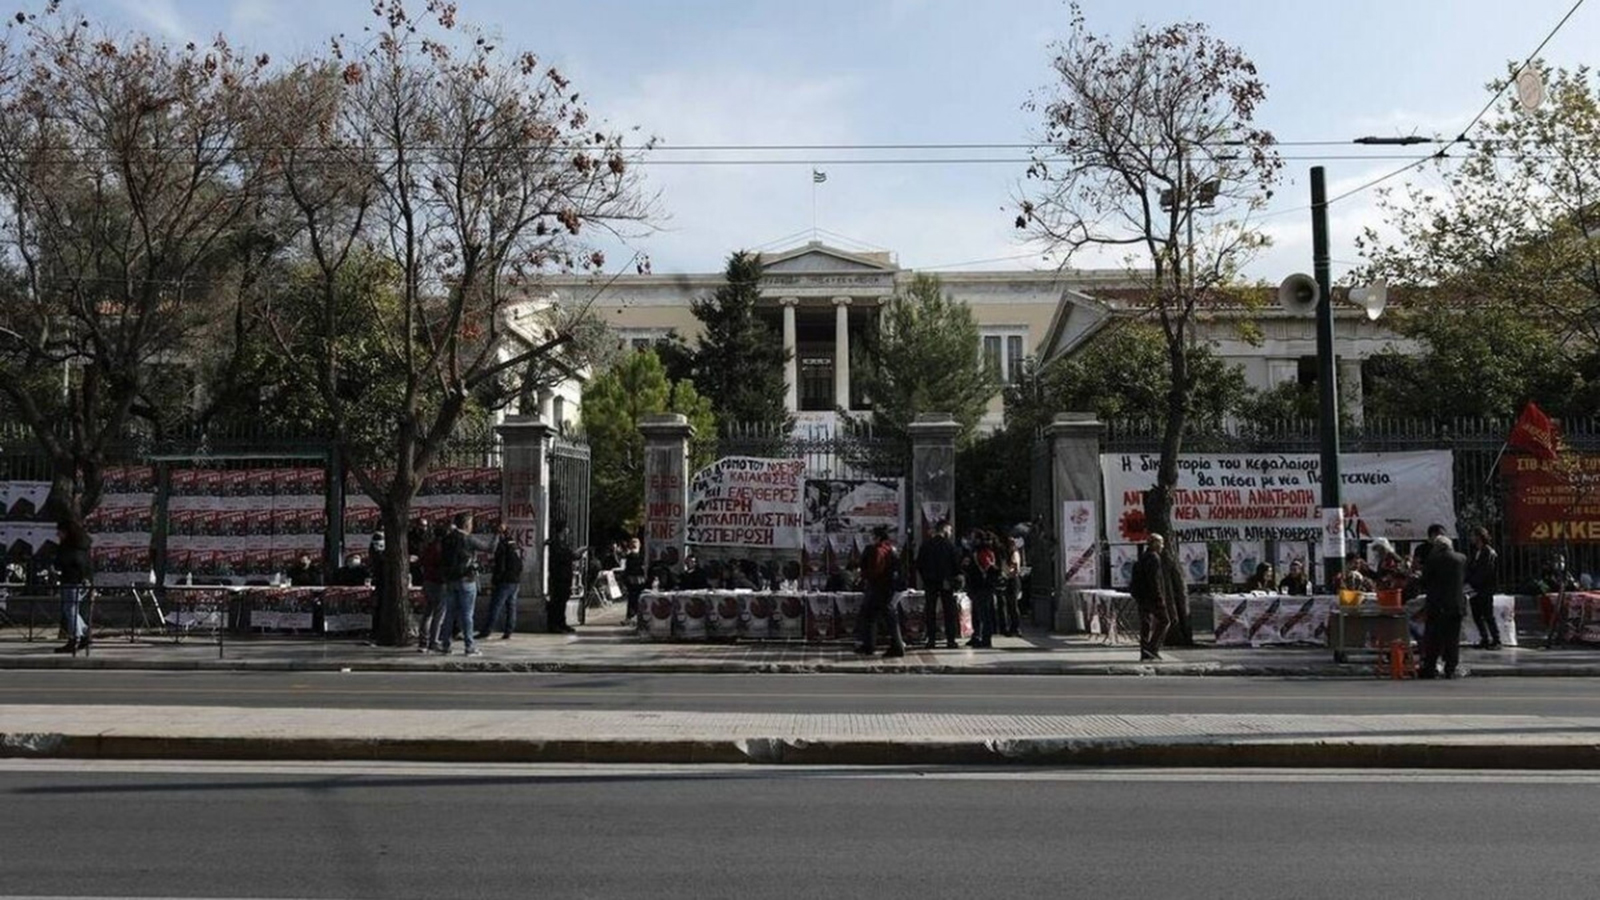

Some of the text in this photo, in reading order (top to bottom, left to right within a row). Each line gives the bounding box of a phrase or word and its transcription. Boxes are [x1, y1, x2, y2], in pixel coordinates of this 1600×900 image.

[1122, 455, 1319, 475] Η δικτορία του κεφαλαίου
[1198, 470, 1391, 488] θα πέσει με νέα Ποτεχνεία
[1249, 488, 1315, 505] ΑΝΑΤΡΟΠΗ
[508, 503, 535, 519] ΗΠΑ
[1175, 506, 1200, 520] ΝΕΑ
[1207, 505, 1308, 520] ΚΟΜΜΟΥΝΙΣΤΙΚΗ
